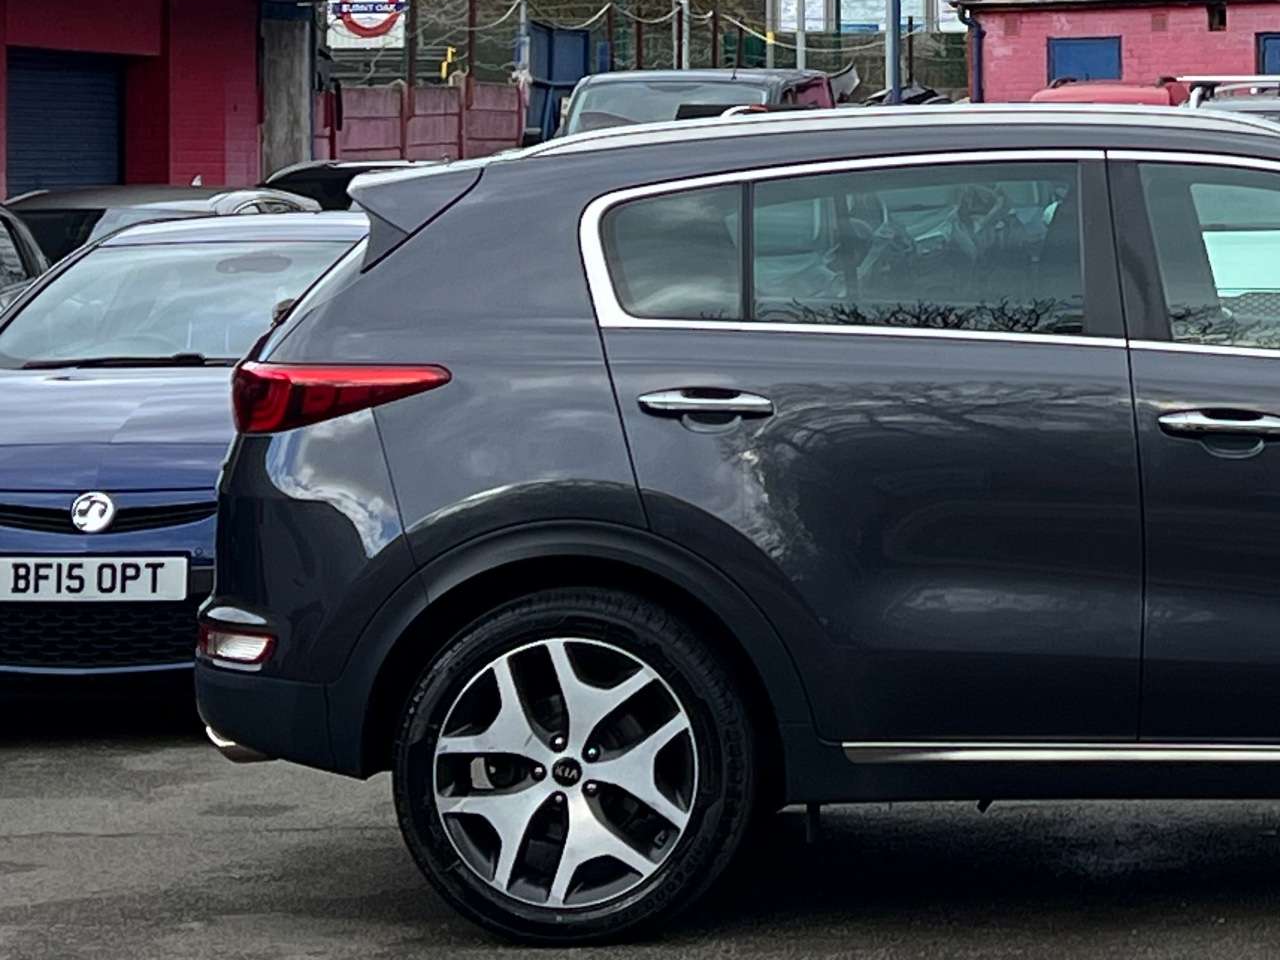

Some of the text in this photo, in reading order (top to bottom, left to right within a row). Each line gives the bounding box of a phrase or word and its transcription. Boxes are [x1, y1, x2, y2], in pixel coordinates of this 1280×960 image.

[11, 563, 165, 594] BF15 OPT
[555, 765, 578, 780] KIA
